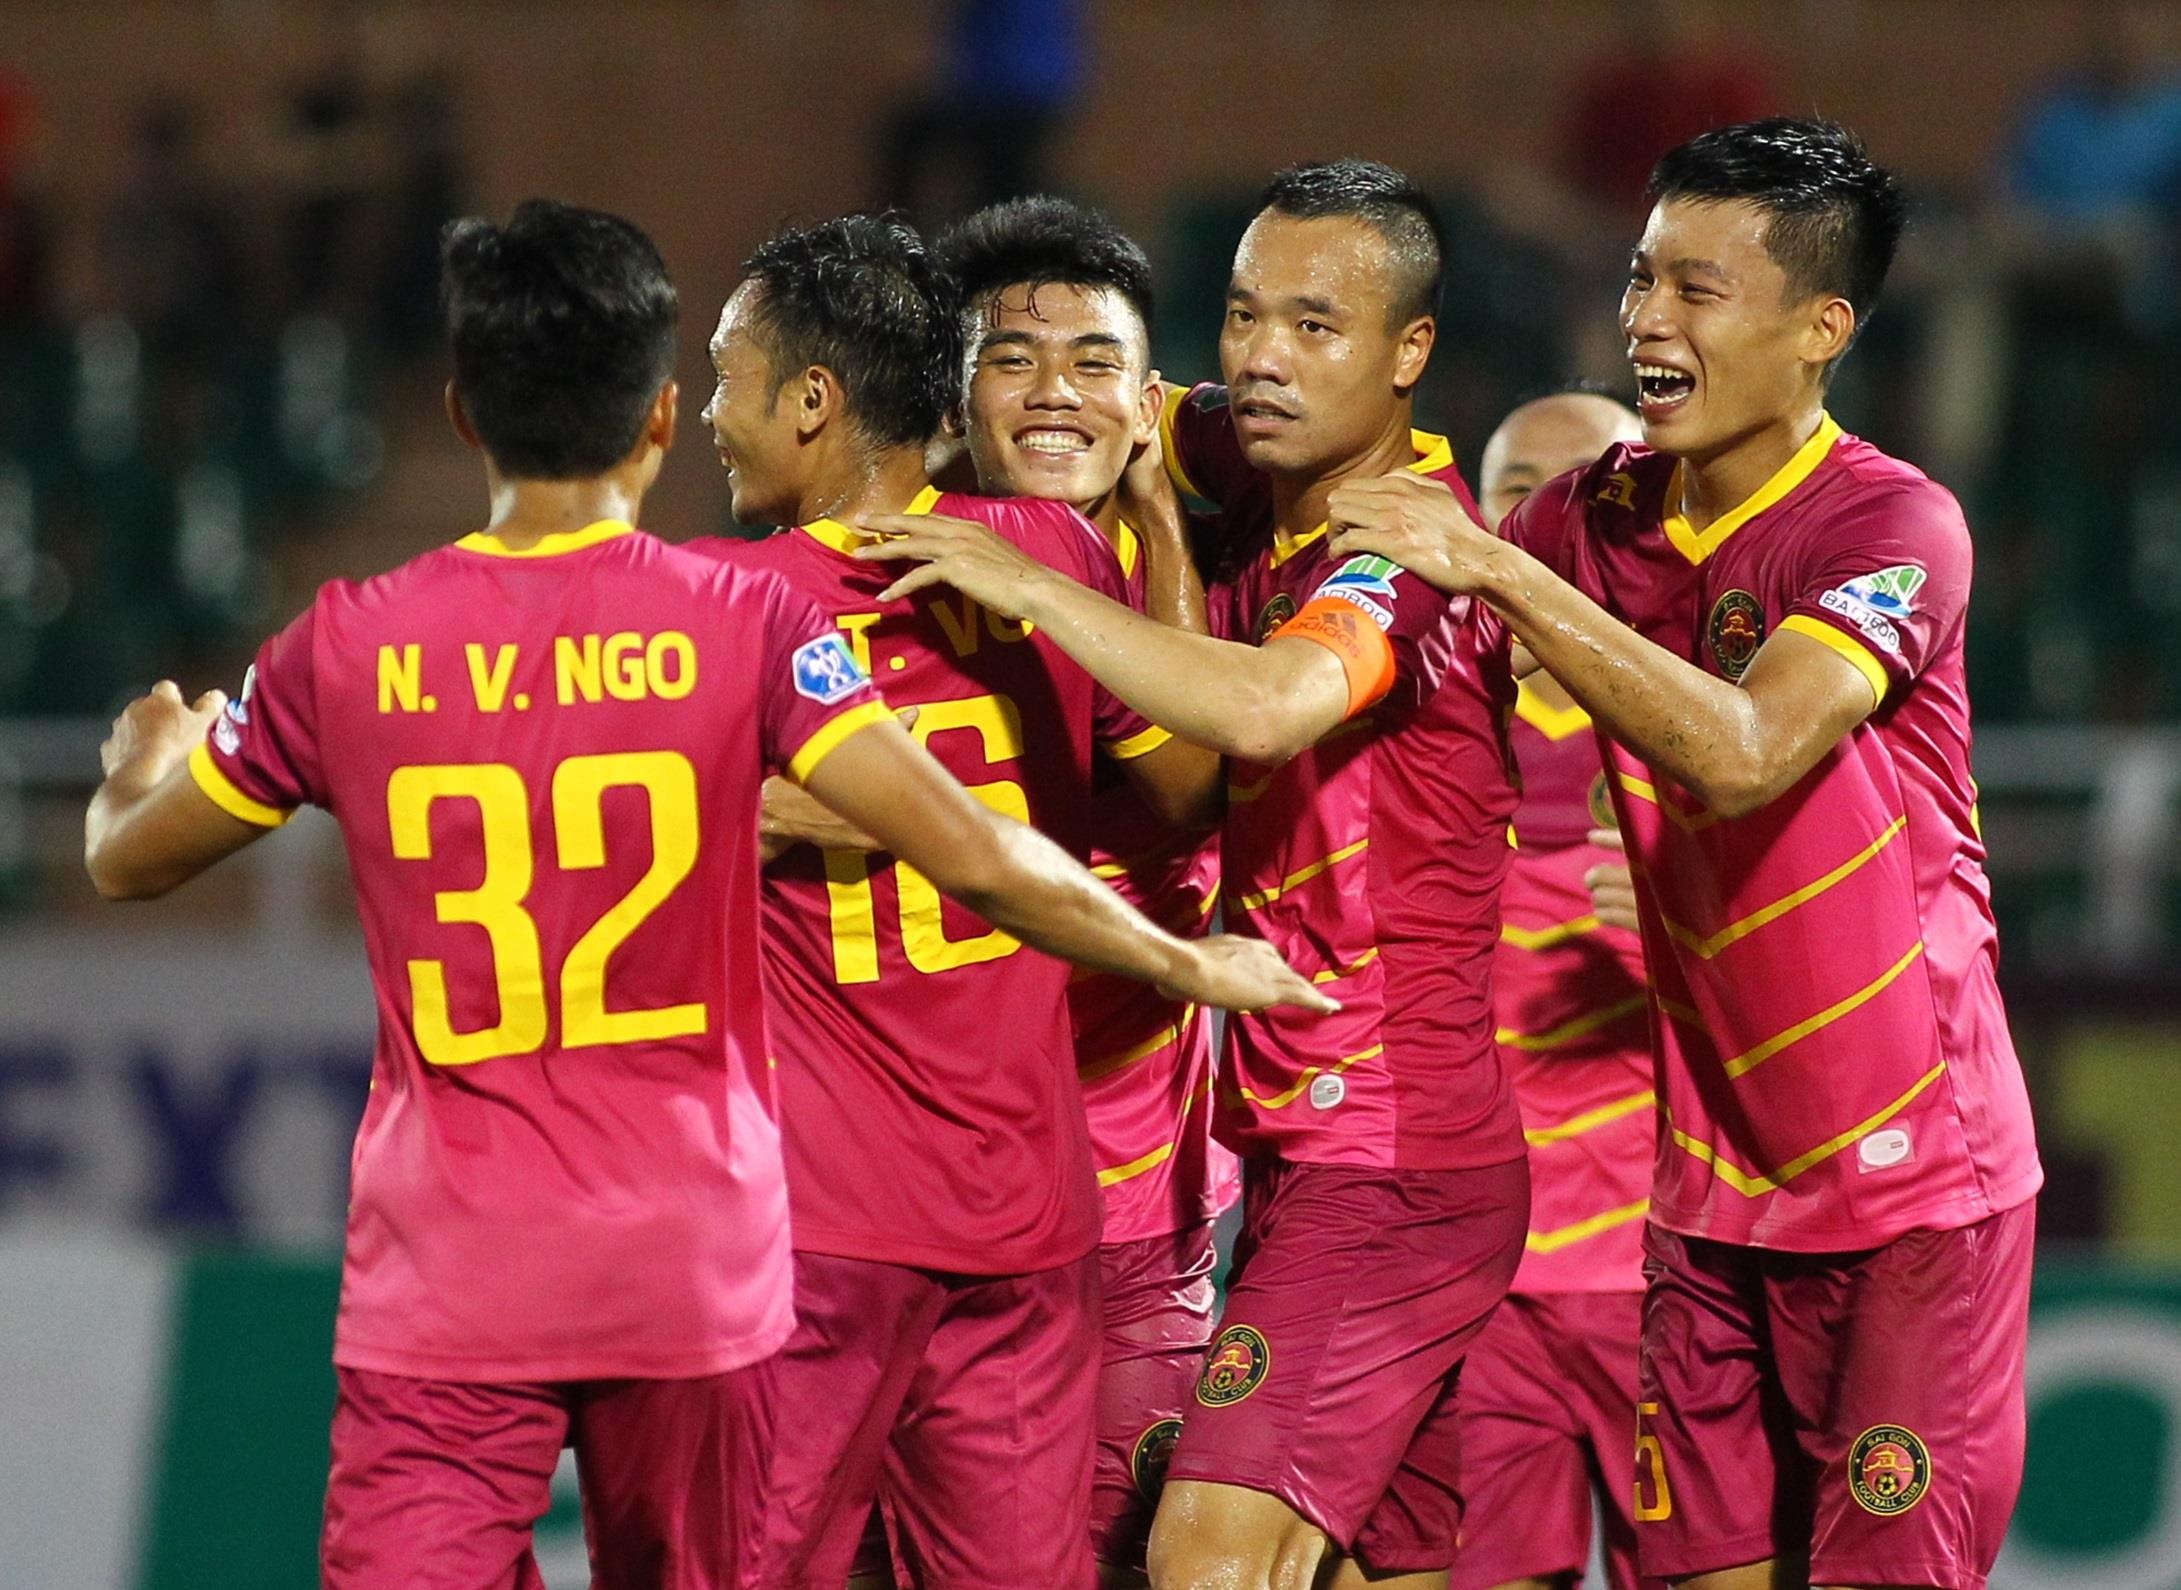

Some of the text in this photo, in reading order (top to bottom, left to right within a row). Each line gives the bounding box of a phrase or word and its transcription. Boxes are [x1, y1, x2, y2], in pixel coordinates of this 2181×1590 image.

[377, 630, 698, 713] N. V. NGO
[835, 613, 906, 676] T.
[387, 750, 706, 1066] 32
[1856, 1480, 1921, 1507] FOOTBALL CLUB
